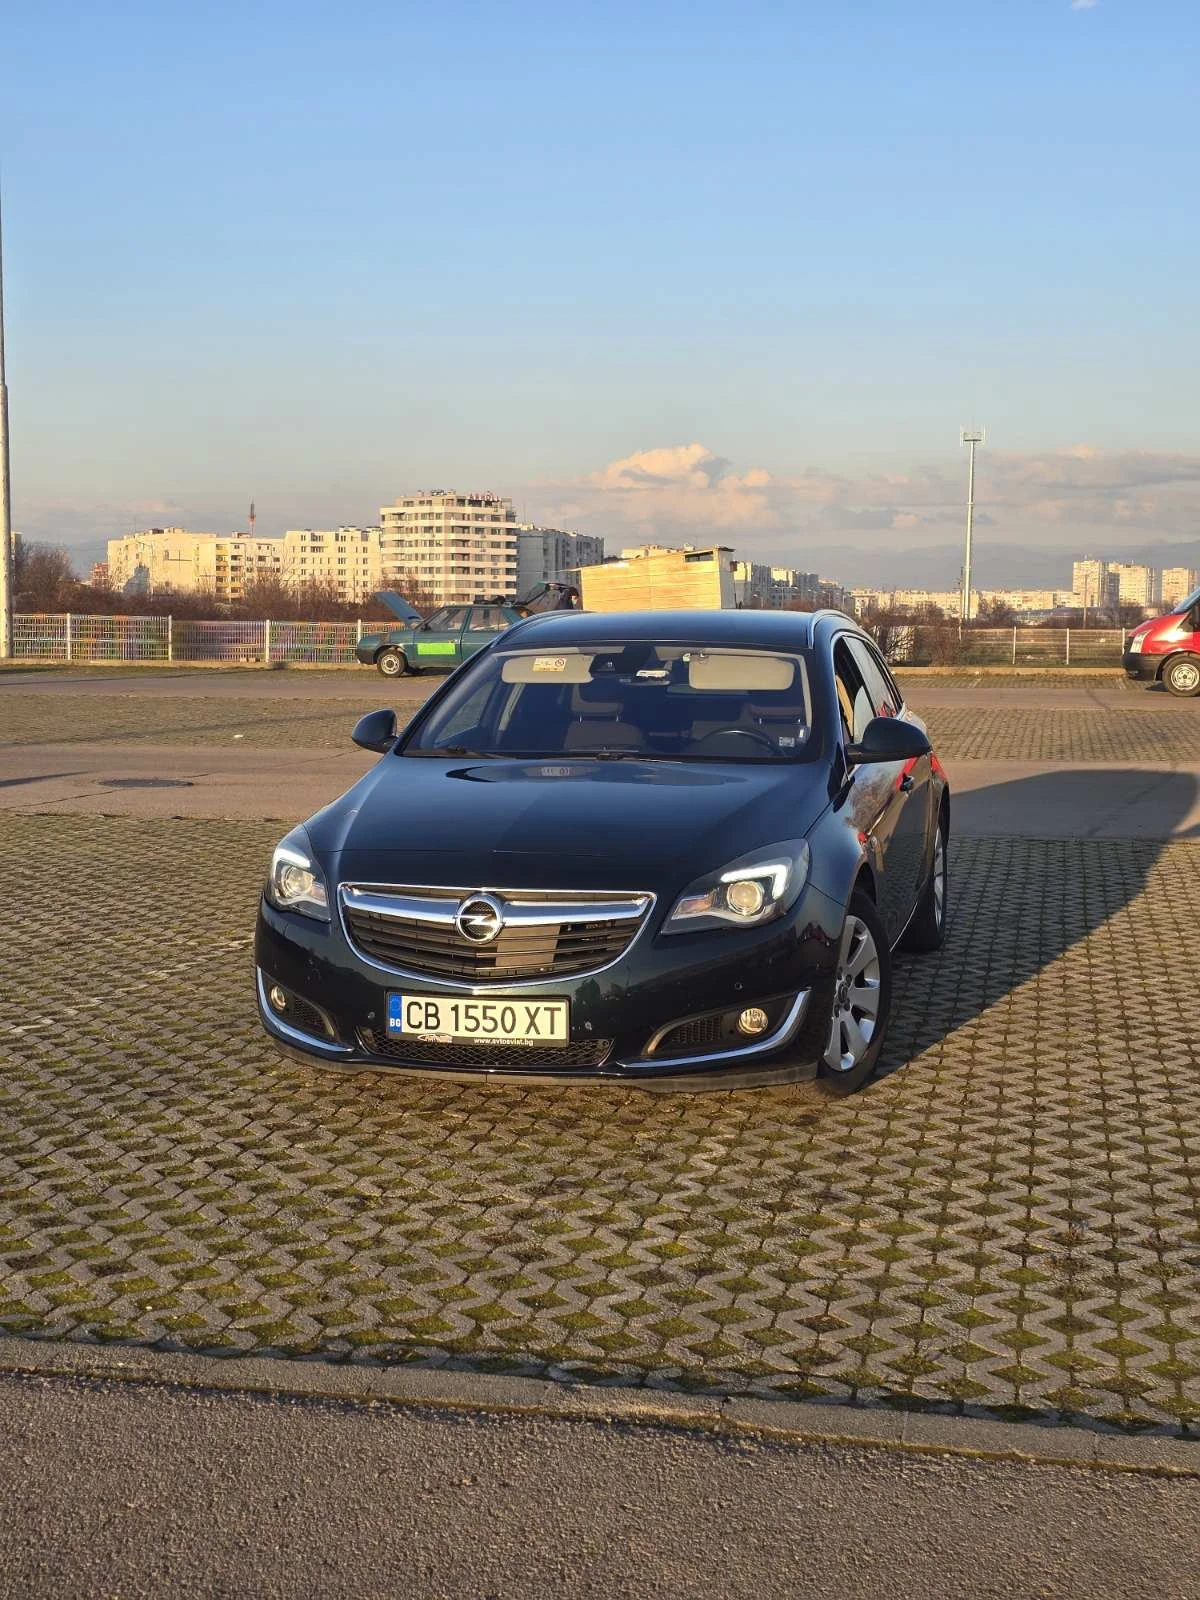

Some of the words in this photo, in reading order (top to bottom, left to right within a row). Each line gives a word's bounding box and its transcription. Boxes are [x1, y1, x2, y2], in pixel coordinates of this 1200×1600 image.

[389, 1018, 401, 1027] BG
[406, 1001, 441, 1030] CB
[450, 1004, 517, 1034] 1550
[524, 1006, 562, 1035] XT
